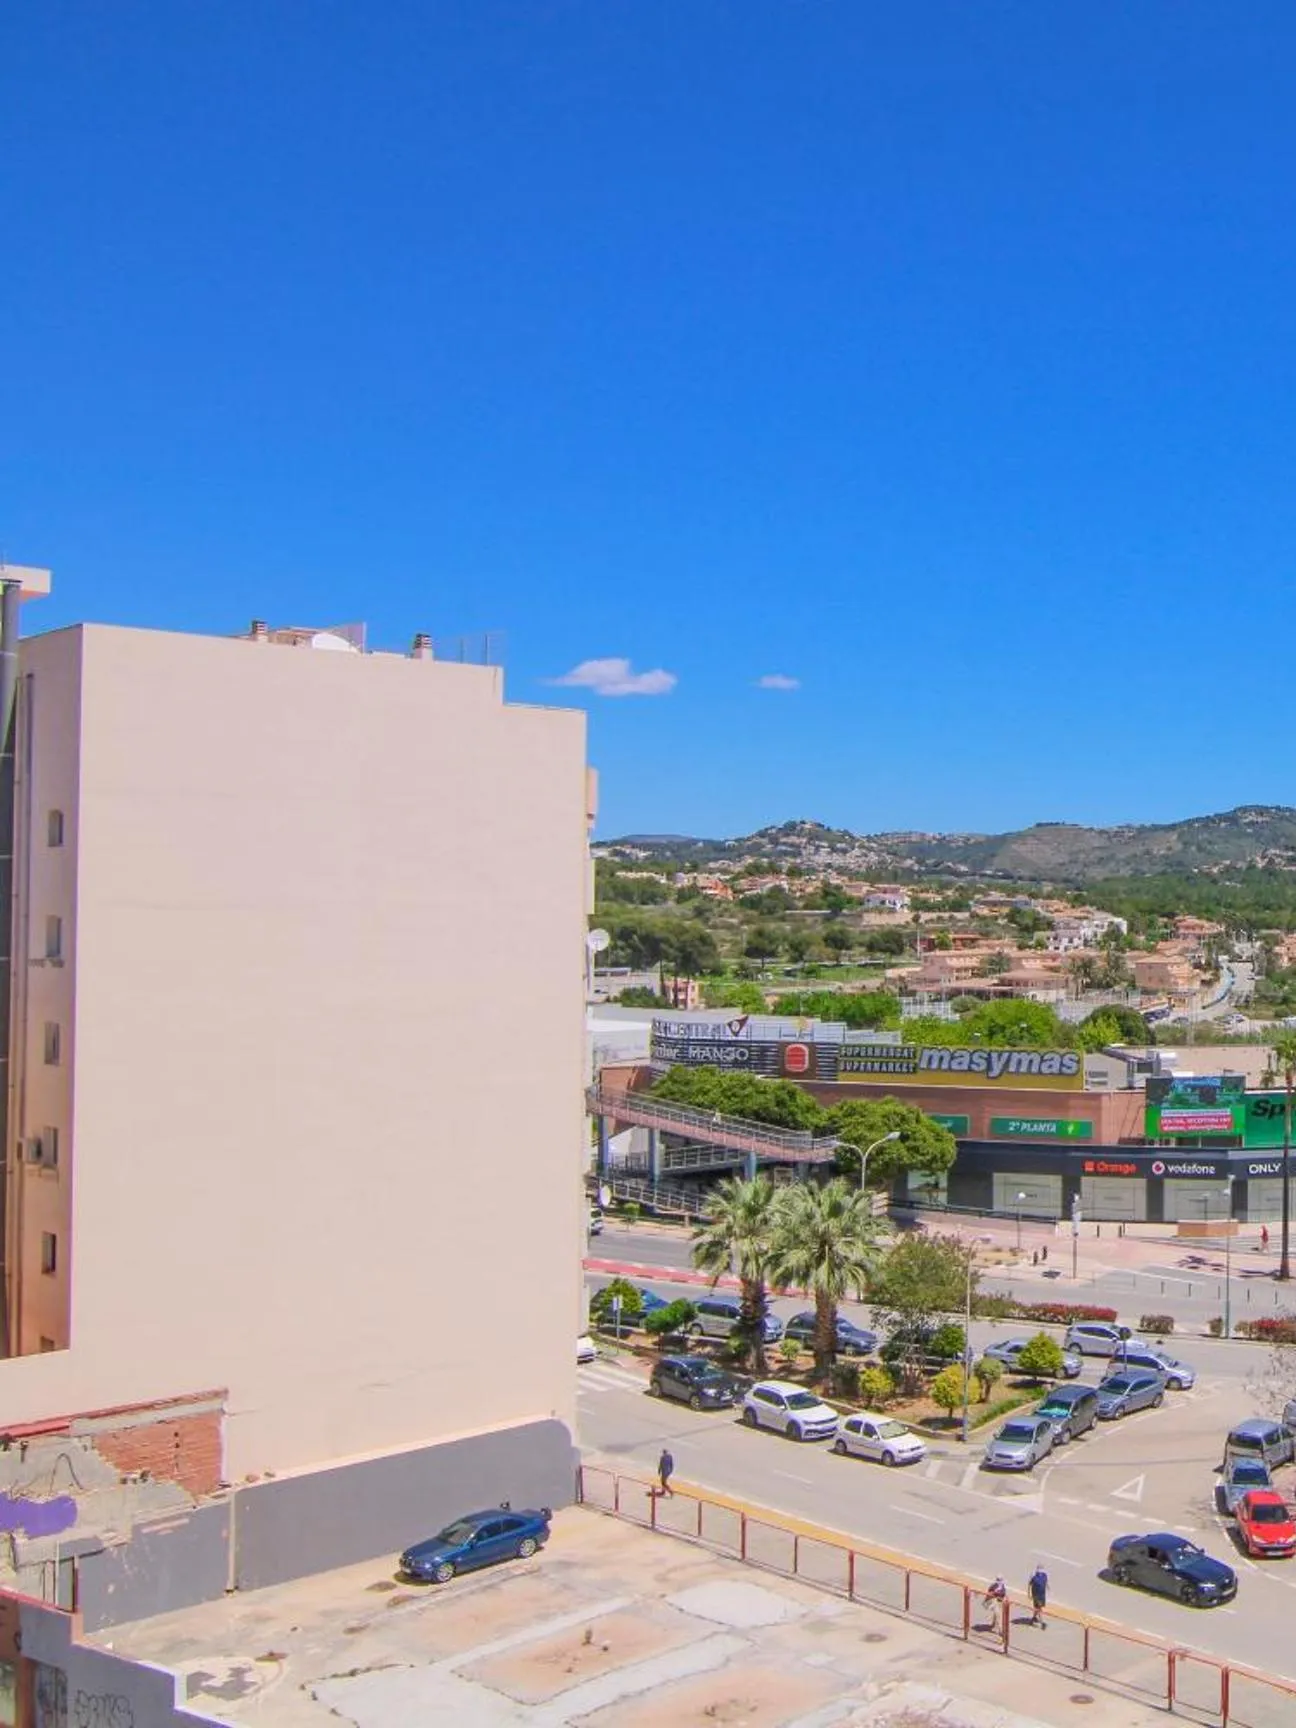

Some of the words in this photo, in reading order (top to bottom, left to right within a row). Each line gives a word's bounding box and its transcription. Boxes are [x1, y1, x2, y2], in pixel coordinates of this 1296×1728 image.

[919, 1048, 1080, 1078] masymas
[1021, 1121, 1057, 1133] PLANTA
[1099, 1161, 1137, 1174] Orange
[1167, 1161, 1216, 1175] vodafone
[1248, 1162, 1281, 1174] ONLY
